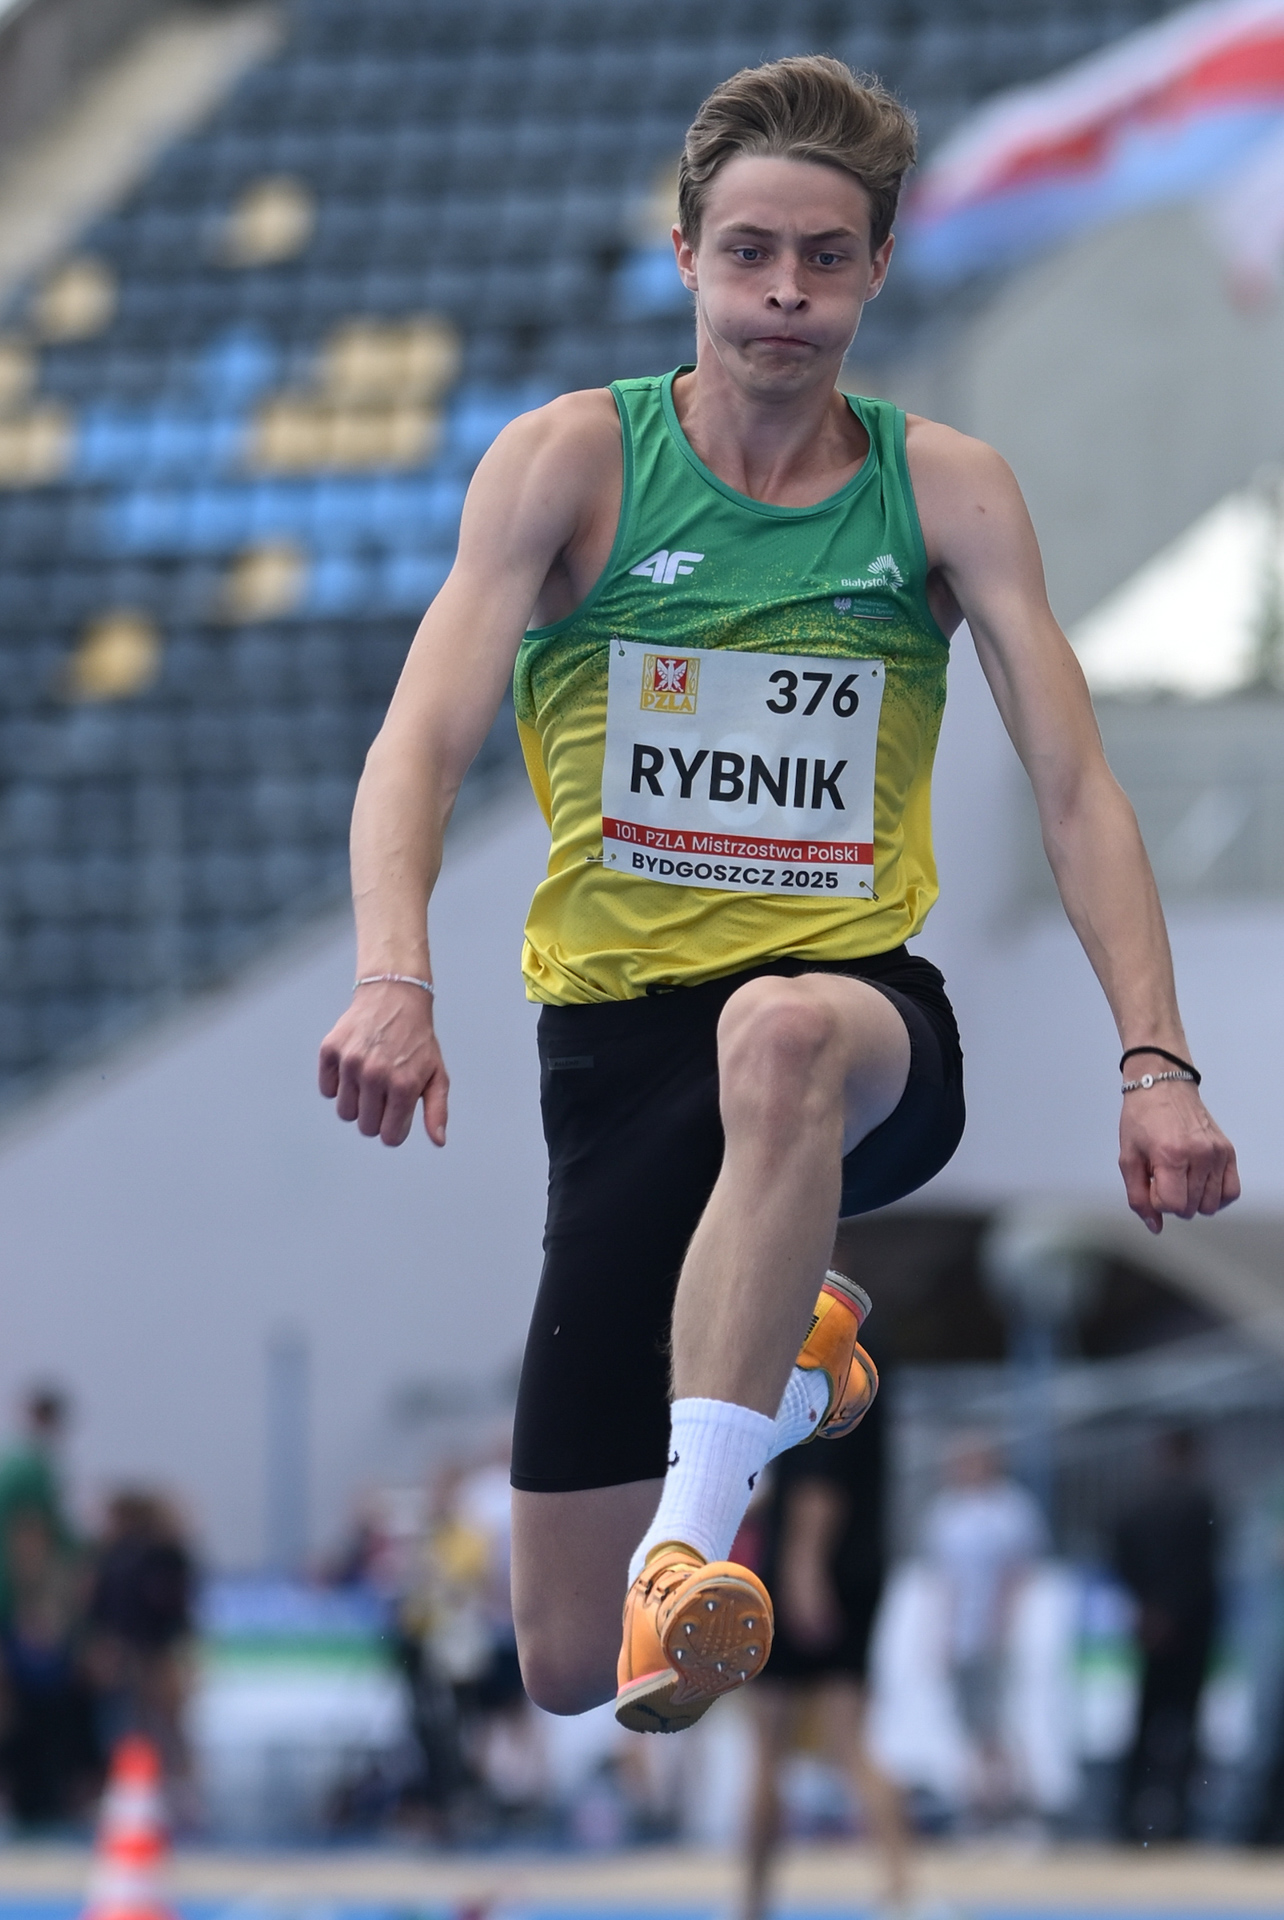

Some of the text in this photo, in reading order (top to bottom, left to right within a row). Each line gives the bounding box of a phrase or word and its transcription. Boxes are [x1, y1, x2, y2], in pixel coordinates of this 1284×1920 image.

[629, 549, 705, 585] 4F
[643, 692, 694, 711] PZLA
[765, 669, 860, 718] 376
[630, 743, 849, 811] RYBNIK
[615, 822, 859, 862] 101. PZLA Mistrzostwa Polski
[631, 851, 839, 889] BYDGOSZCZ 2025
